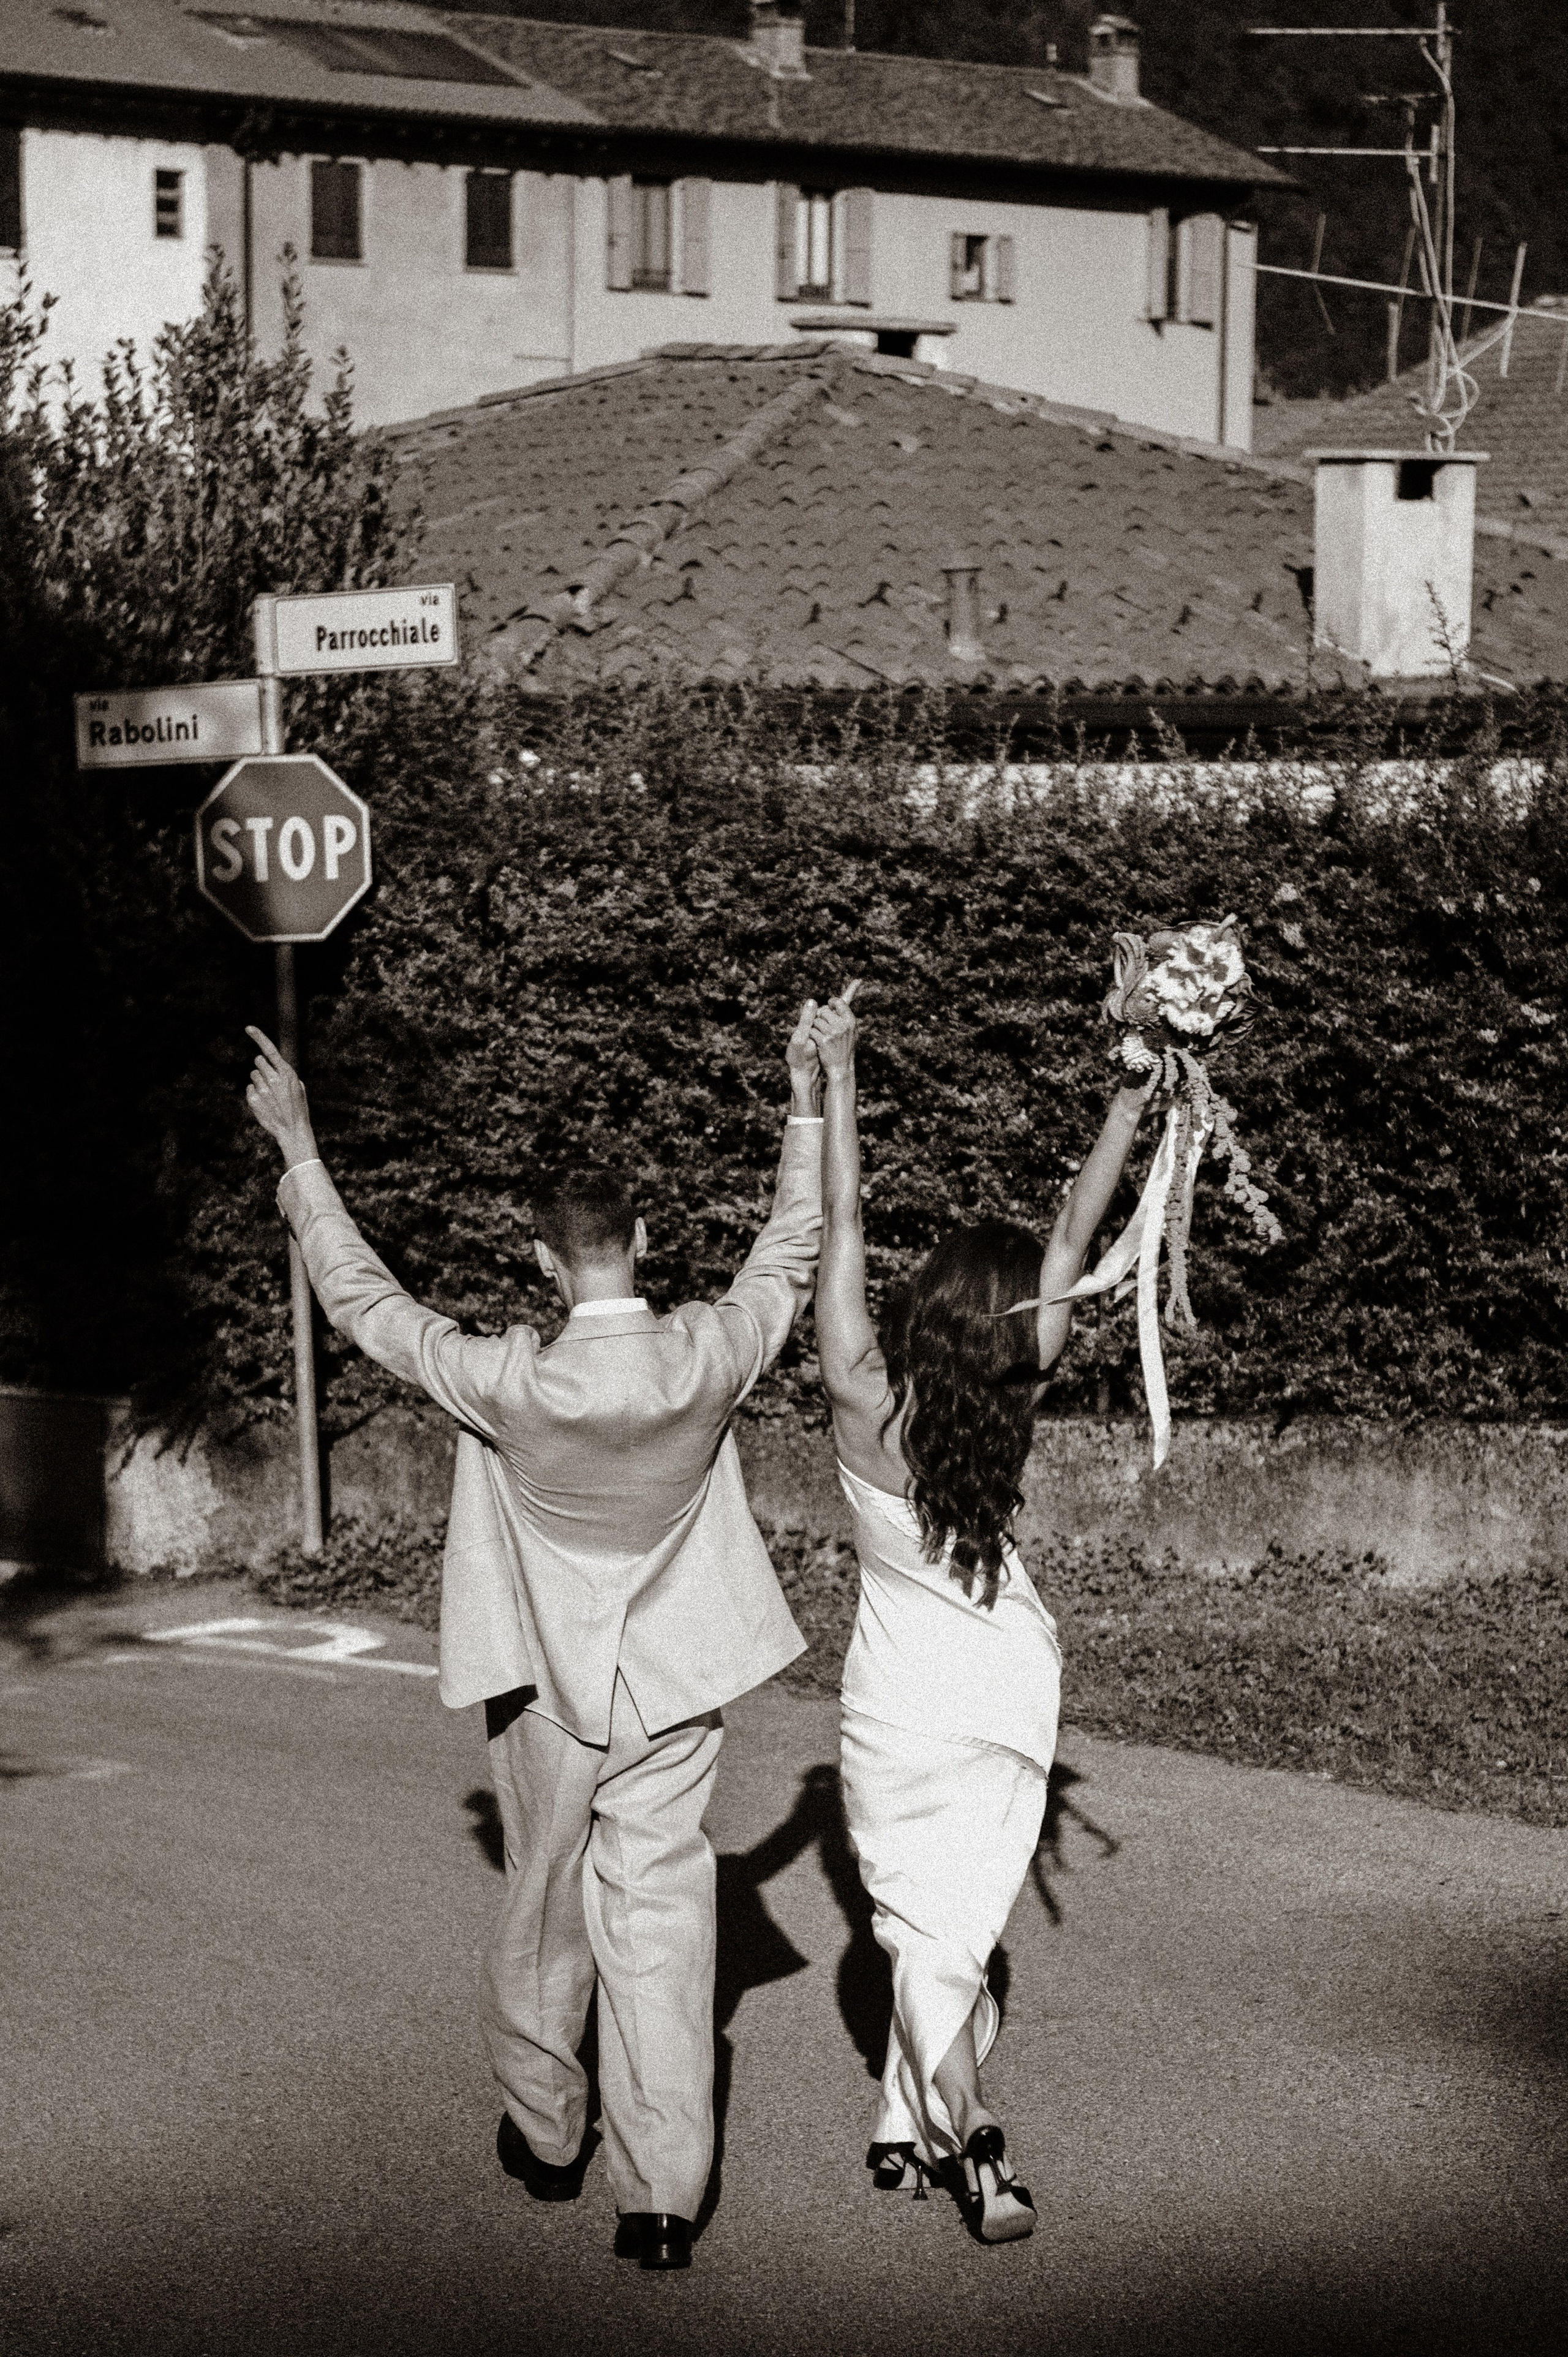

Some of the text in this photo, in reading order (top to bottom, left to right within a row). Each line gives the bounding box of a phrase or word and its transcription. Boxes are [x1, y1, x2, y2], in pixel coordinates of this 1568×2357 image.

[420, 594, 440, 606] via
[315, 617, 440, 651] Parrocchiale
[89, 714, 199, 747] Rabolini
[211, 815, 357, 882] STOP
